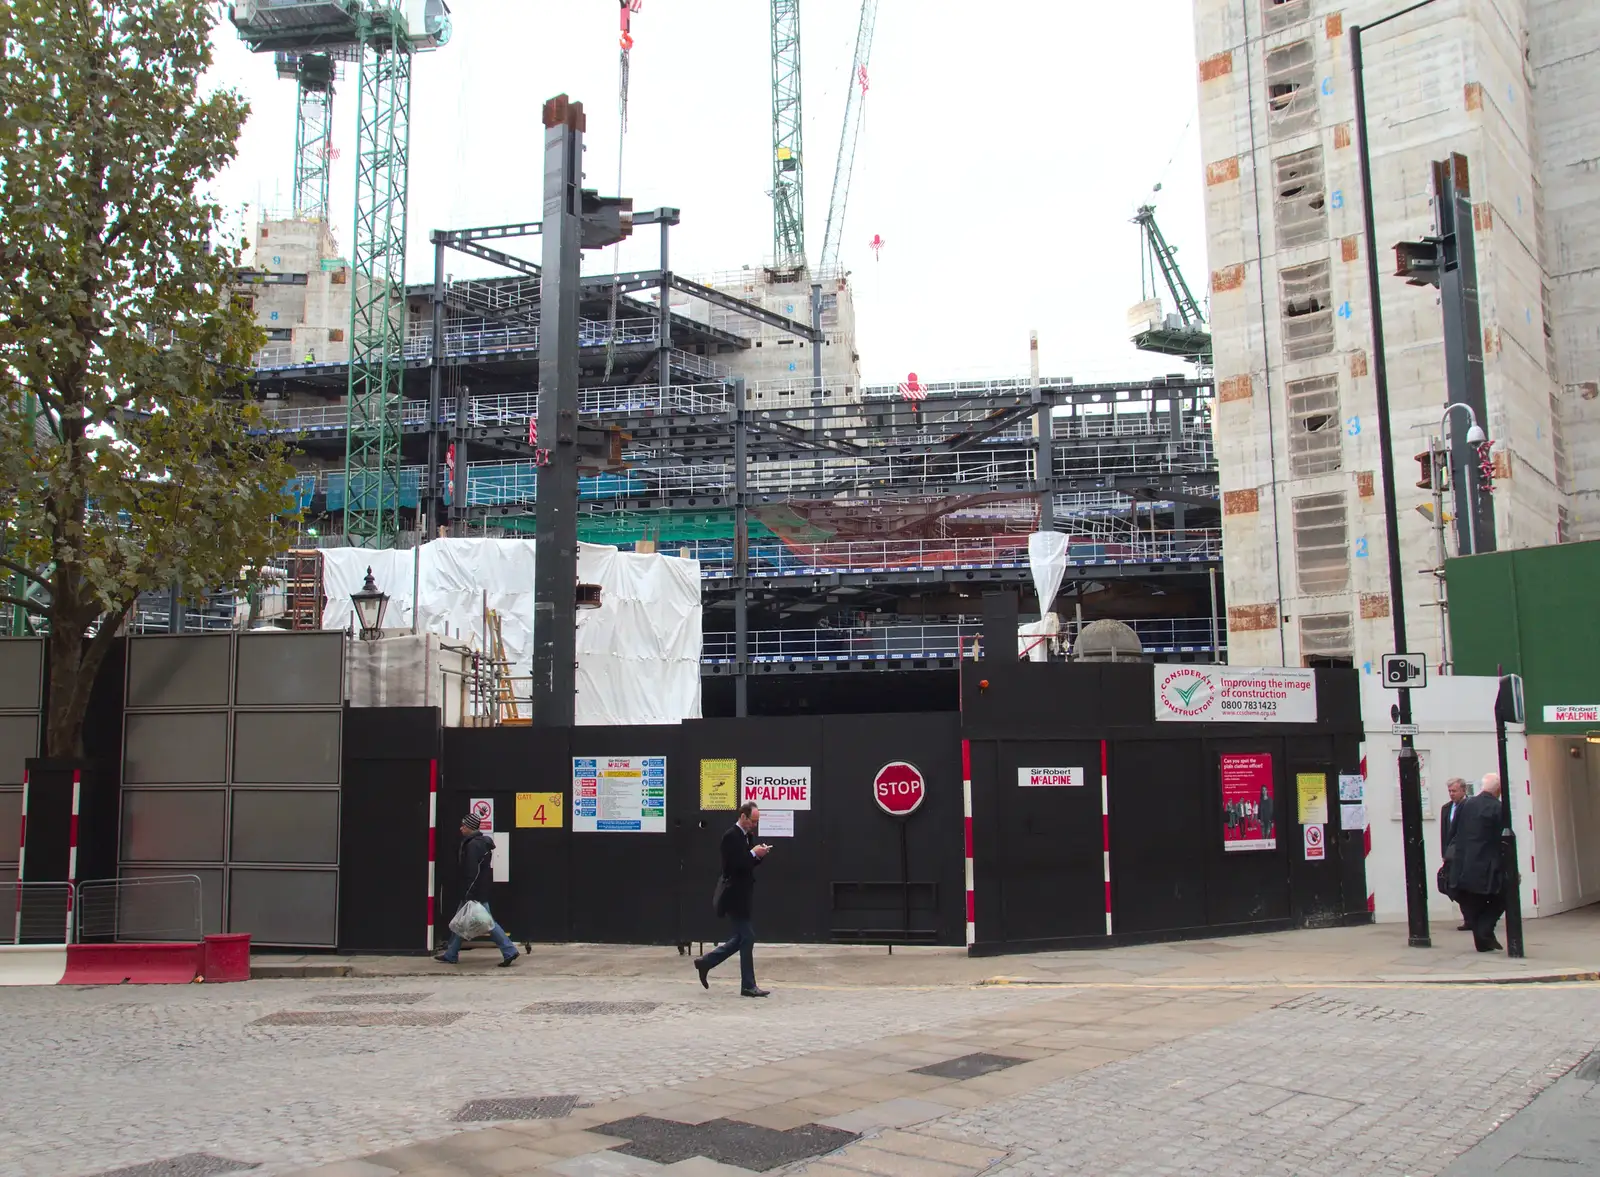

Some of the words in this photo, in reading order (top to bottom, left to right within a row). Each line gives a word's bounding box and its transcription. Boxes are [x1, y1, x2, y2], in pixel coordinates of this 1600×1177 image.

[1331, 190, 1343, 209] 5
[1338, 301, 1352, 319] 4
[1347, 416, 1361, 436] 3
[1356, 538, 1369, 558] 2
[1161, 670, 1216, 691] CONSIDERATE
[1221, 678, 1266, 690] Improving
[1269, 679, 1282, 688] the
[1284, 679, 1310, 691] image
[1221, 688, 1230, 697] of
[1232, 689, 1286, 698] construction
[1161, 694, 1214, 716] CONSTRUCTORS
[1221, 701, 1242, 709] 0800
[746, 776, 762, 785] Sir
[764, 776, 806, 786] Robert
[879, 780, 920, 796] STOP
[745, 786, 806, 800] McALPINE
[533, 804, 547, 824] 4
